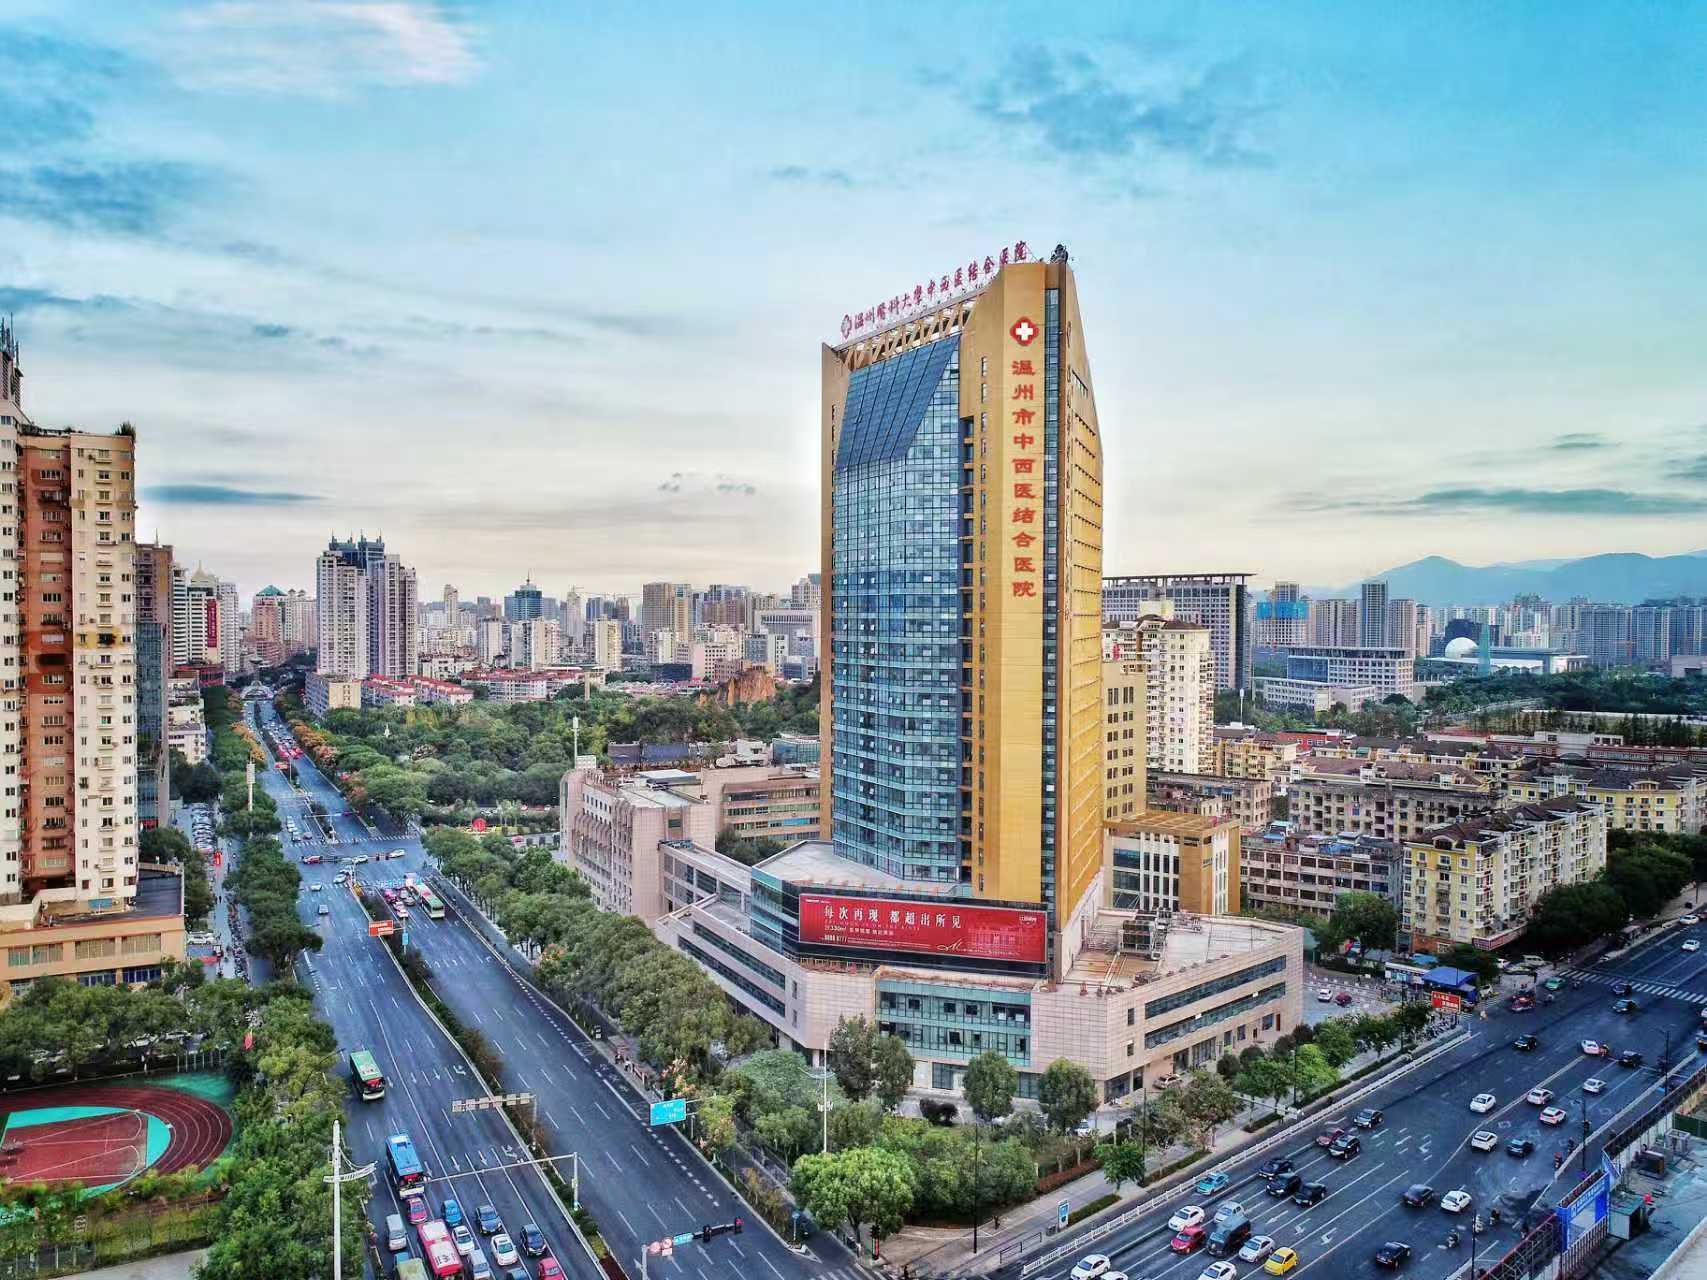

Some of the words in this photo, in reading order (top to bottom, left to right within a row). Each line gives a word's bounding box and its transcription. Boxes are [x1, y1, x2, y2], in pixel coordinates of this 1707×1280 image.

[1012, 360, 1036, 597] 温州市中西医结合医院
[889, 910, 961, 929] 都超出所见
